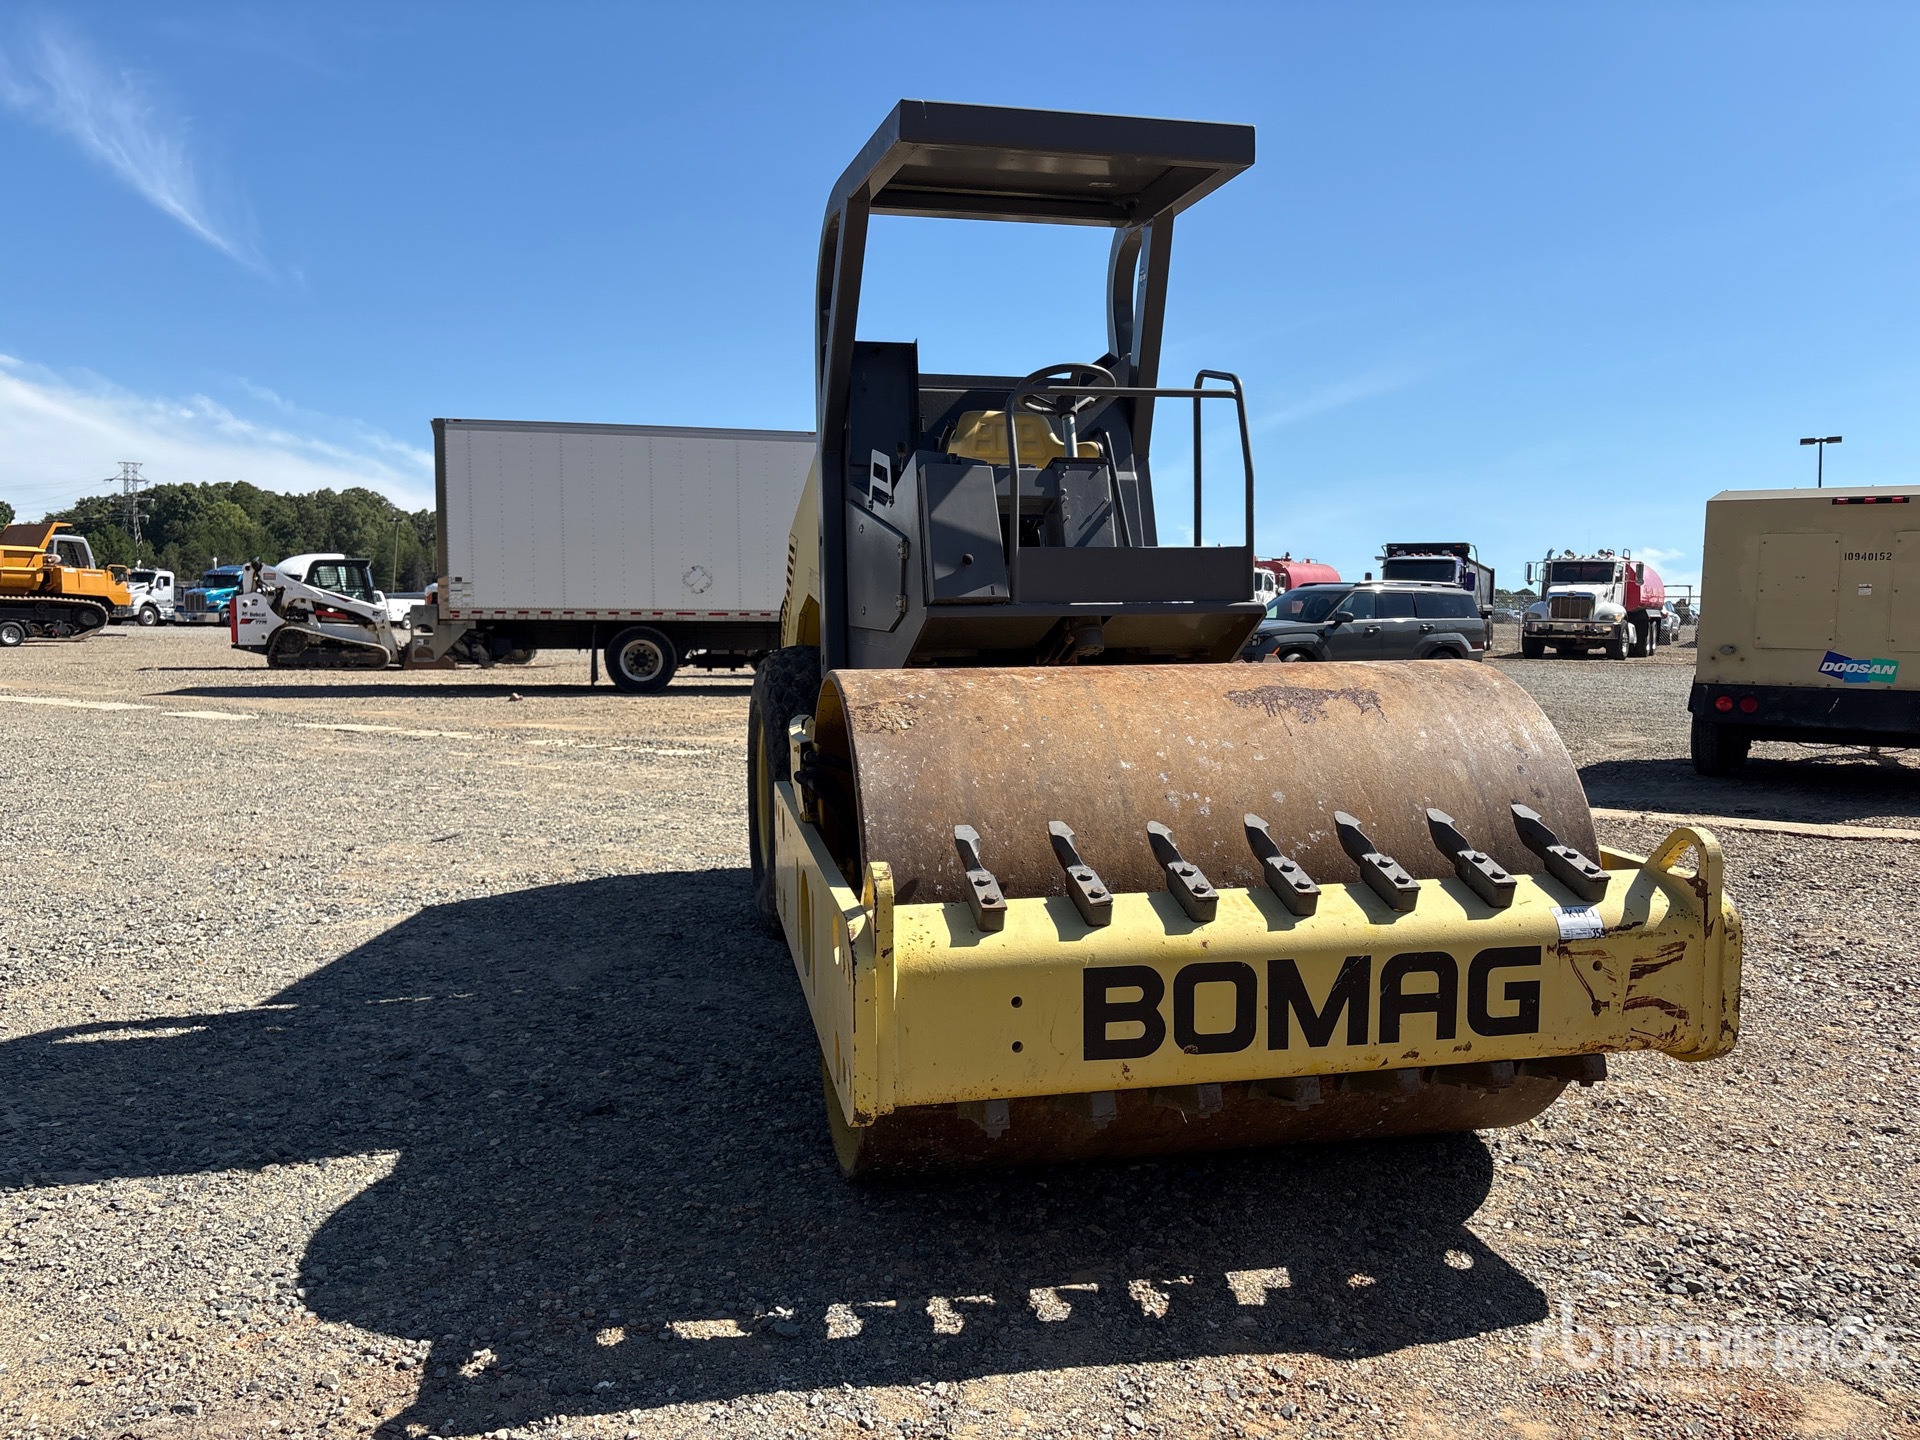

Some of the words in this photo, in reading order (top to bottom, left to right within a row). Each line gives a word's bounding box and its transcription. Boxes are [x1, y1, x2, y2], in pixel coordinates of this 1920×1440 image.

[1844, 552, 1893, 561] 10940152
[1820, 661, 1896, 675] DOOSAN
[1083, 945, 1542, 1061] BOMAG
